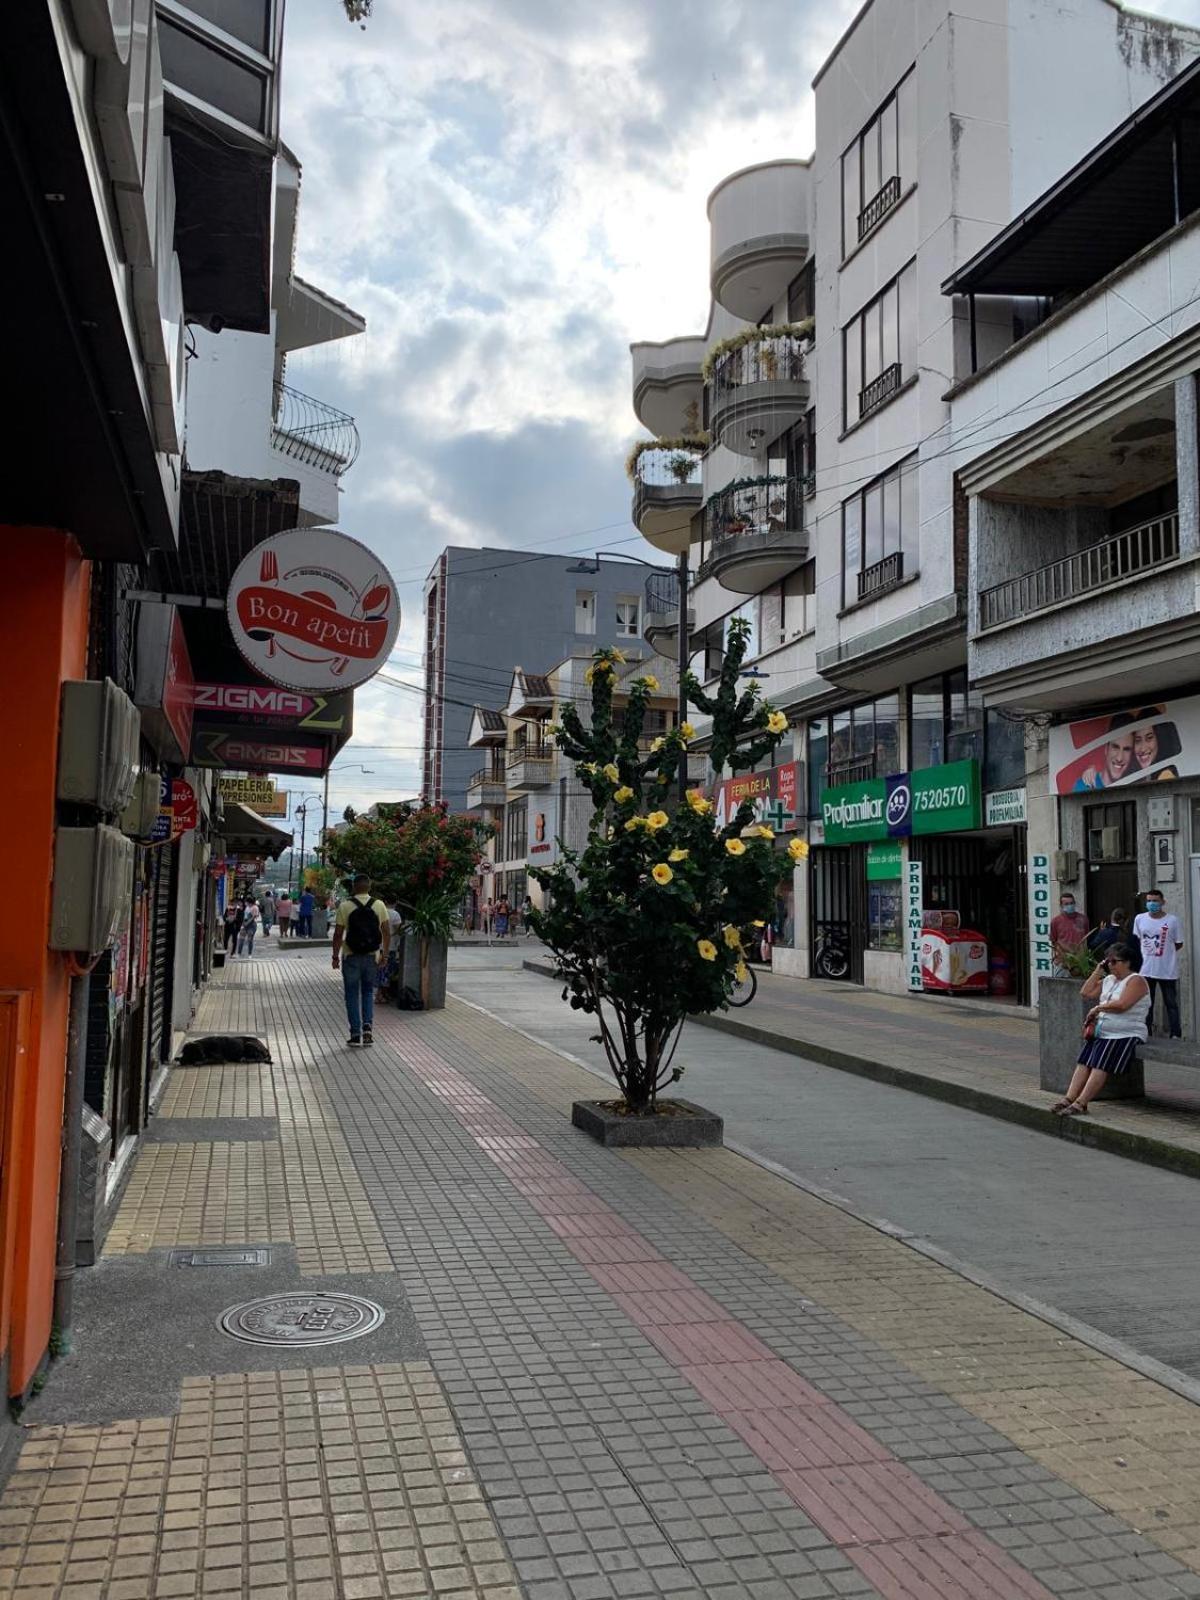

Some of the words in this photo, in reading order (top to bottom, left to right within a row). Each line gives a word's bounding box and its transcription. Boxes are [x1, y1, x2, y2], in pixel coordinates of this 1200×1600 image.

[249, 597, 299, 627] Bon
[306, 615, 373, 650] apetit
[194, 686, 303, 713] ZIGMA
[218, 779, 273, 793] PAPELERIA
[762, 776, 771, 791] LA
[914, 784, 966, 811] 7520570
[729, 796, 772, 825] MDA
[823, 794, 884, 829] Profamiliar
[908, 862, 921, 986] PROFAMILIAR
